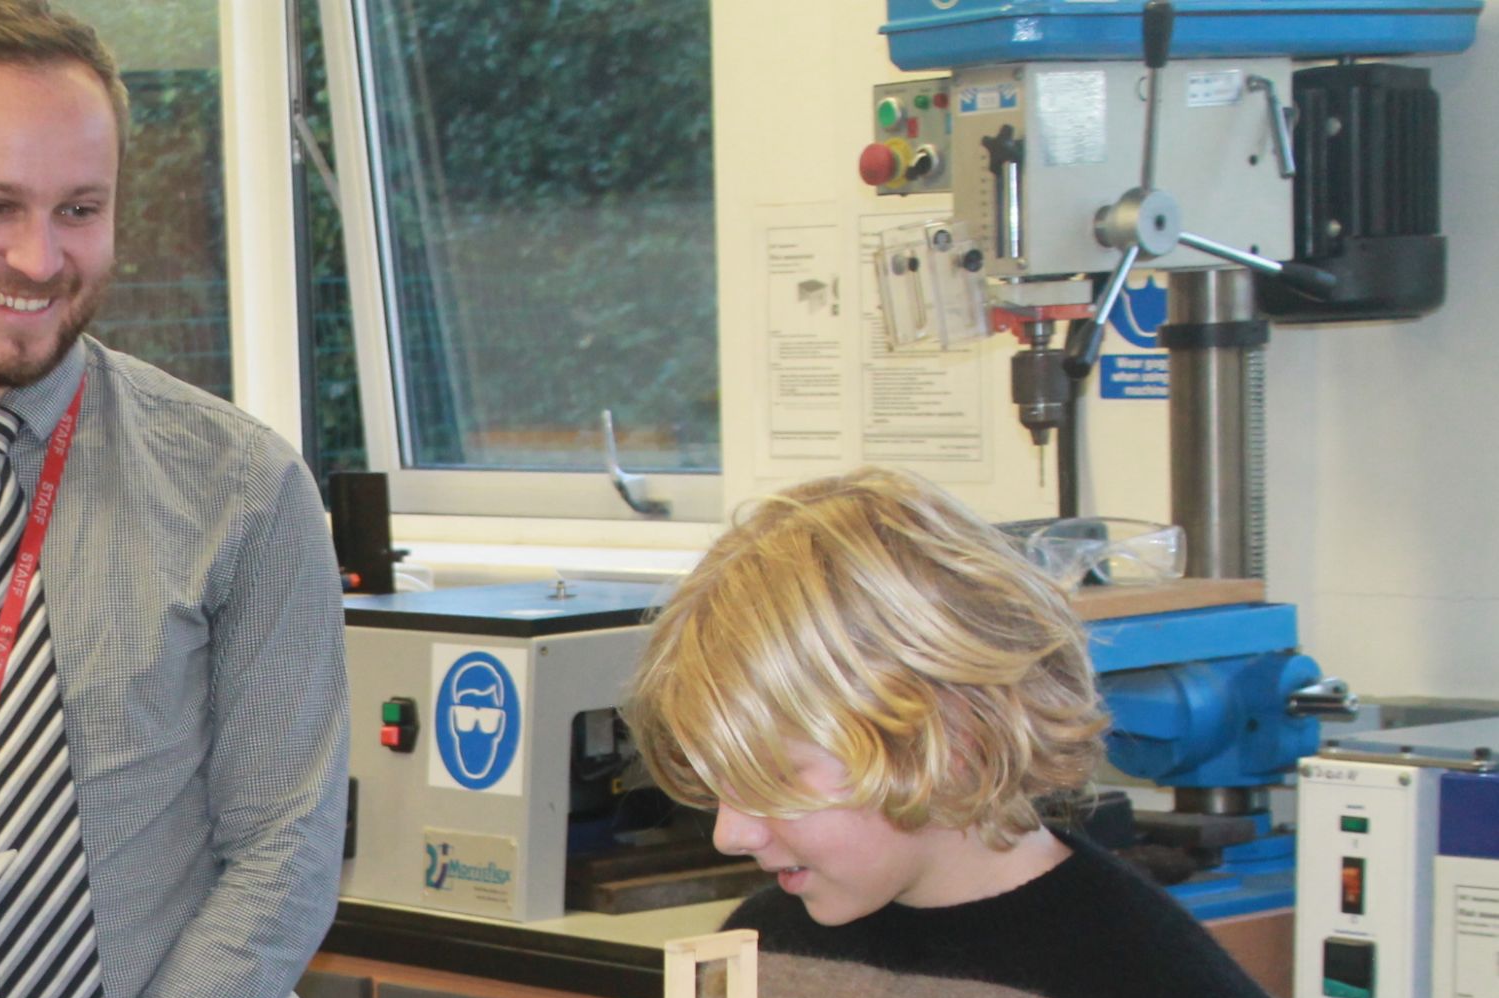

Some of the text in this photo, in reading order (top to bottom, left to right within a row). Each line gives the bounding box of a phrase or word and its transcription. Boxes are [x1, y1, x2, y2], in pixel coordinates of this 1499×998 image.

[54, 414, 73, 455] STAFF
[34, 481, 54, 525] STAFF
[14, 552, 33, 598] STAFF
